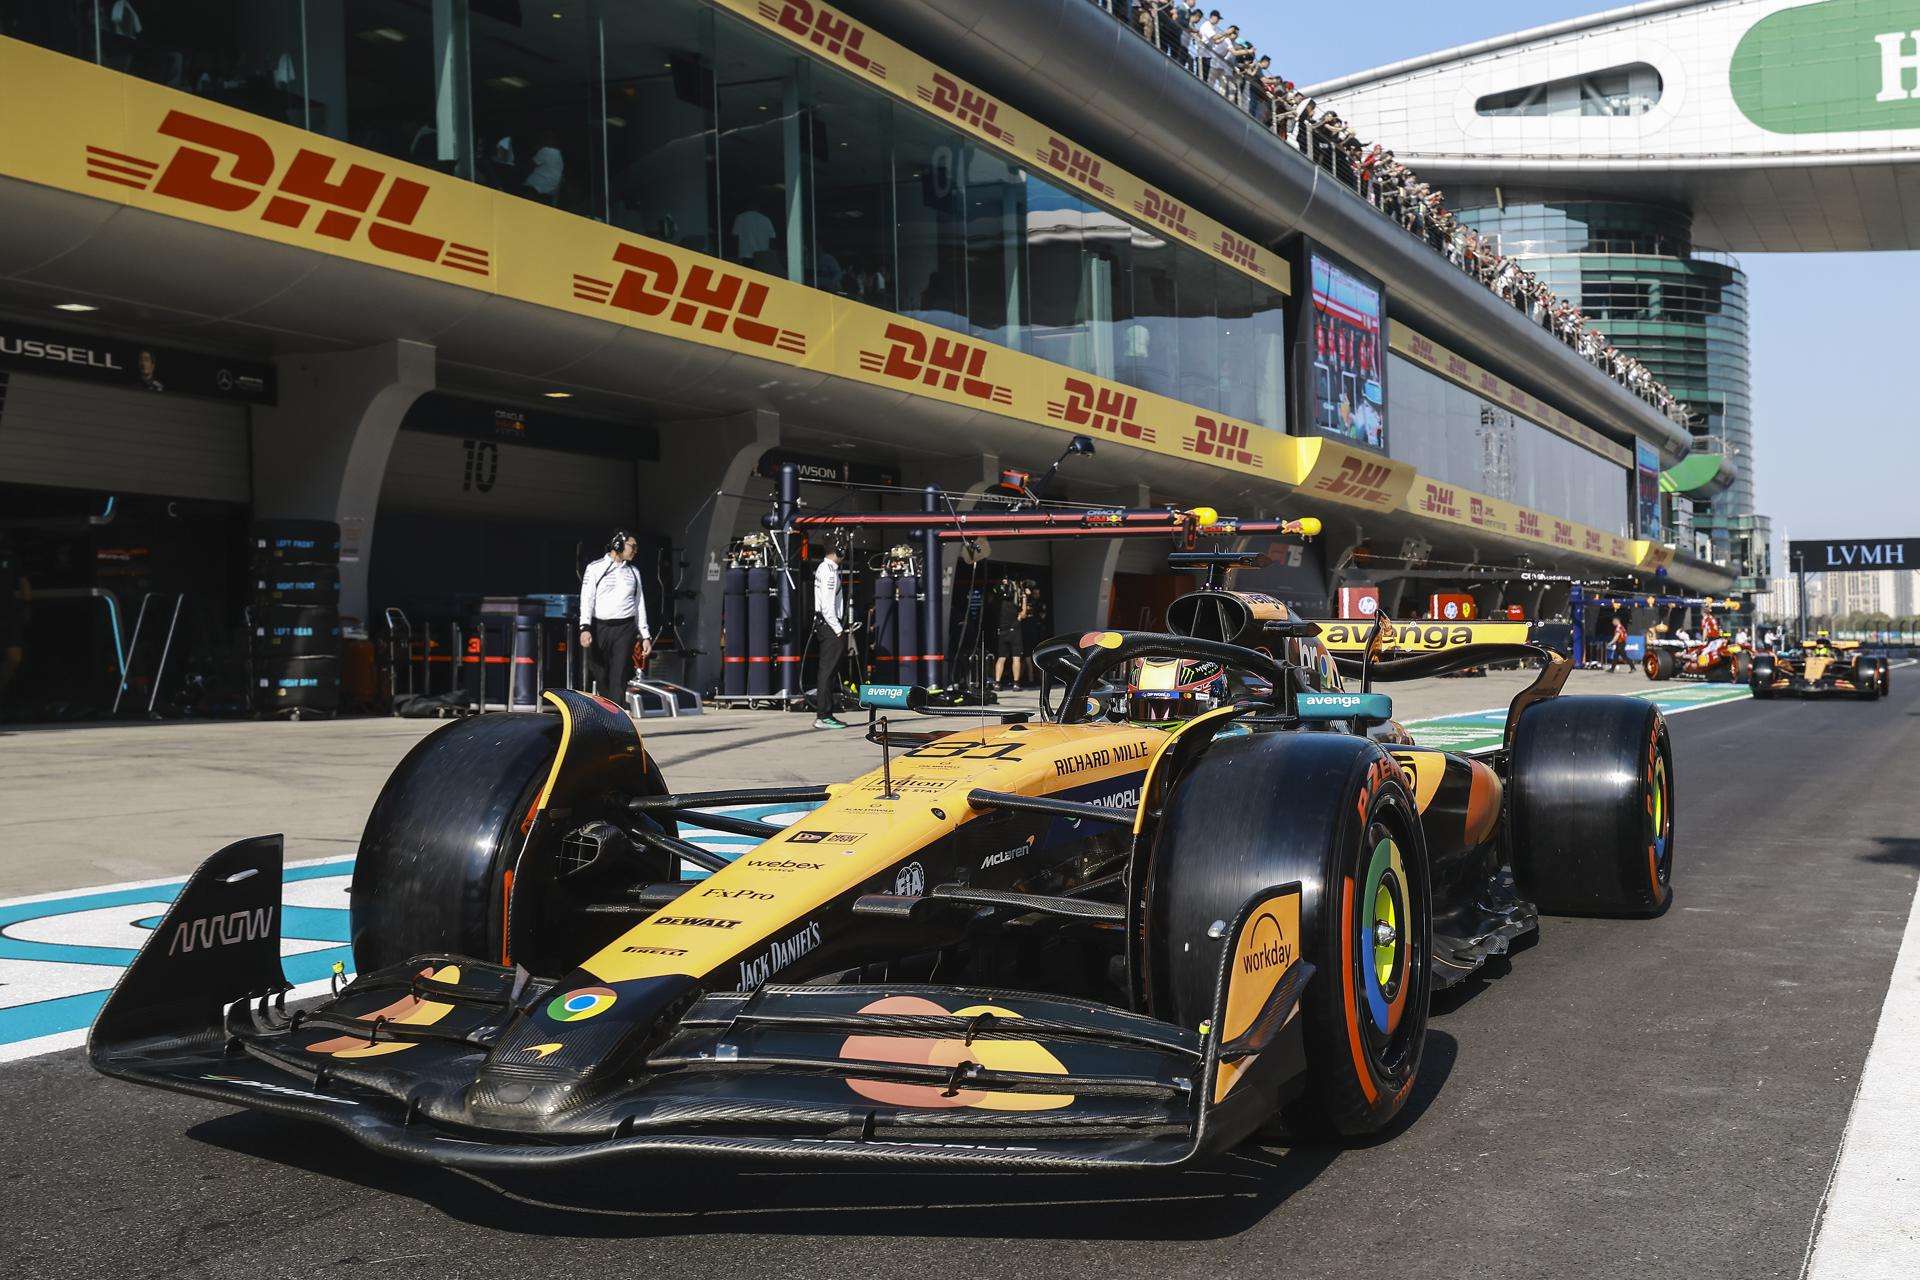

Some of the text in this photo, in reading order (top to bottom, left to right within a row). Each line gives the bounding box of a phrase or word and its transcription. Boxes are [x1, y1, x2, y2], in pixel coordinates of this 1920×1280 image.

[778, 0, 870, 70] DHL
[932, 72, 1004, 140] DHL
[1048, 136, 1103, 193] DHL
[153, 109, 445, 262] DHL
[1143, 188, 1188, 238] DHL
[1220, 231, 1259, 273] DHL
[610, 243, 783, 347] DHL
[0, 335, 123, 371] USSELL
[883, 323, 994, 401] DHL
[1064, 377, 1143, 440] DHL
[1194, 415, 1253, 465] DHL
[798, 464, 837, 480] WSON
[1326, 455, 1392, 502] DHL
[1426, 483, 1456, 518] DHL
[1826, 544, 1905, 567] LVMH
[867, 687, 904, 699] avenga
[1306, 695, 1361, 707] avenga
[902, 741, 1026, 763] 81
[1054, 741, 1149, 777] RICHARD MILLE
[747, 859, 825, 871] webex
[981, 844, 1029, 870] McLaren
[701, 888, 775, 901] FxPro
[169, 906, 273, 956] ARROW
[622, 946, 688, 957] PIRELLI
[736, 920, 822, 993] JACK DANIEL'S
[1243, 940, 1292, 974] workday
